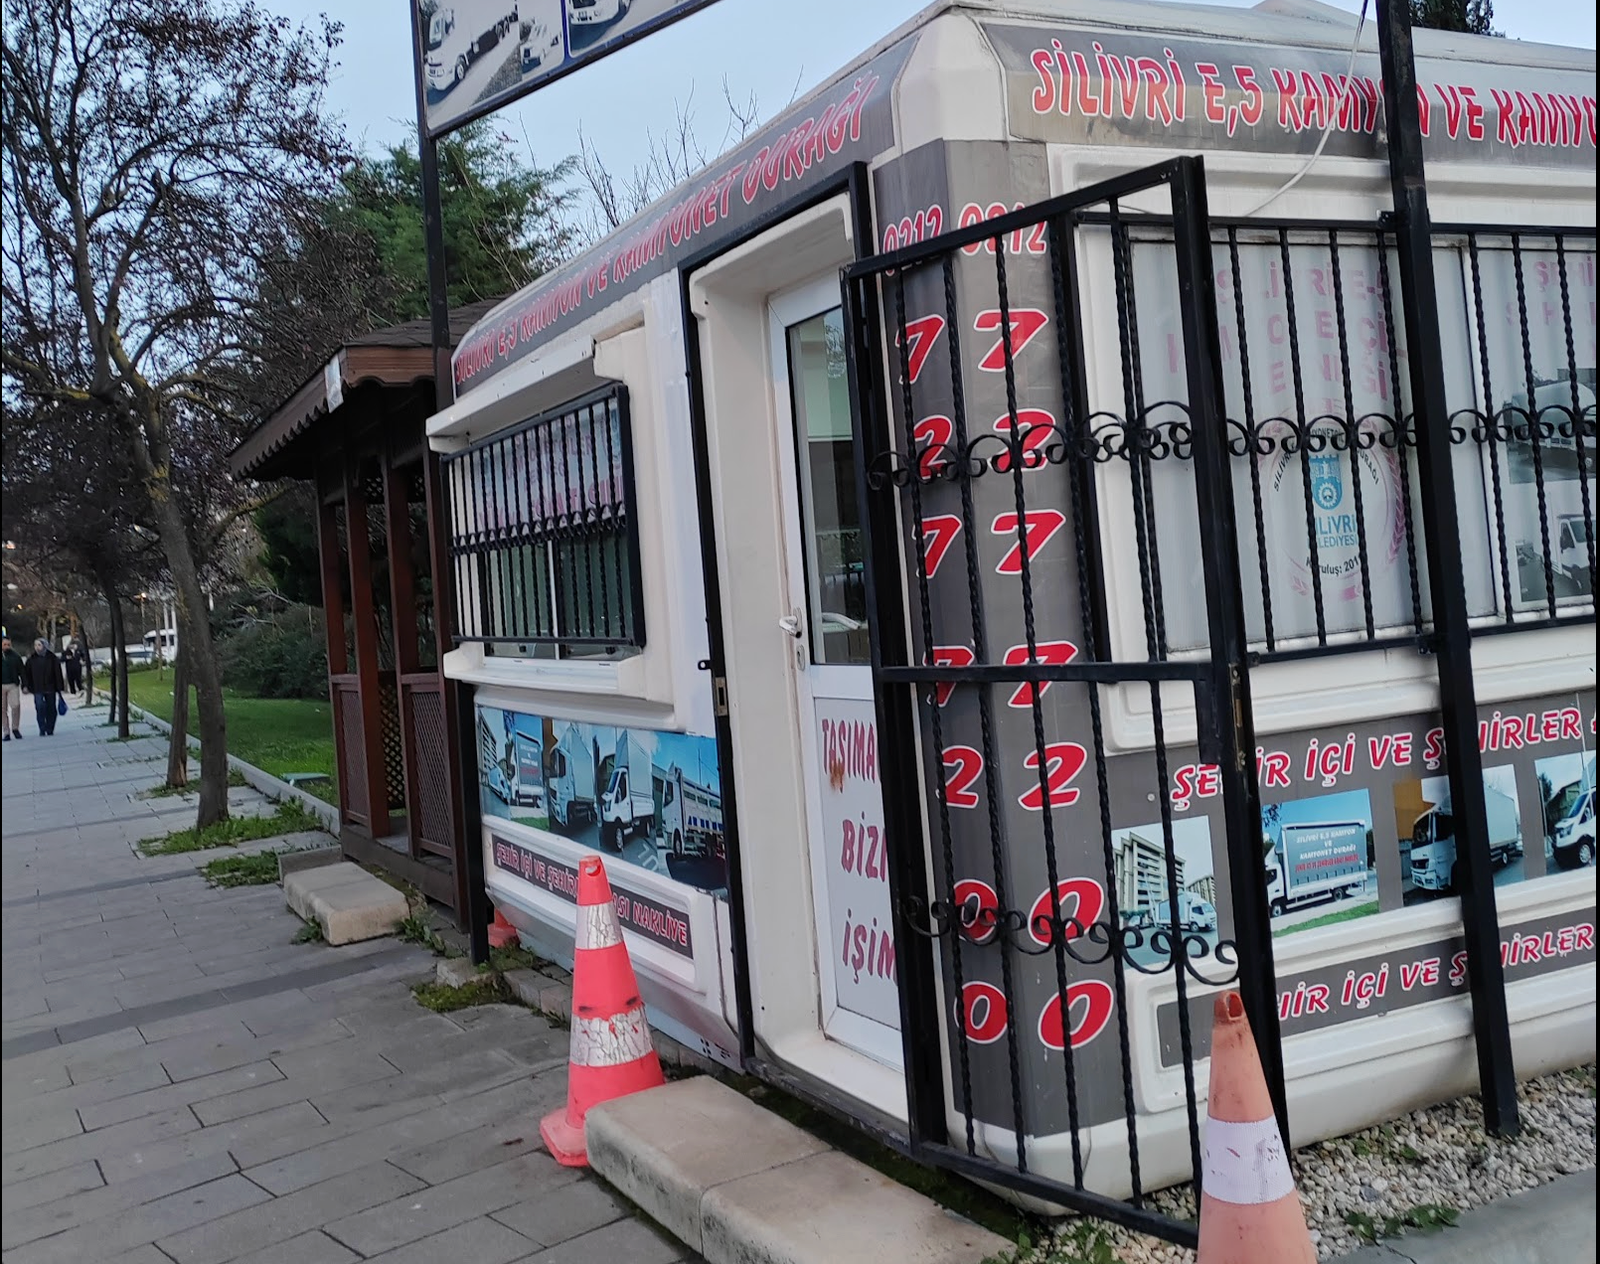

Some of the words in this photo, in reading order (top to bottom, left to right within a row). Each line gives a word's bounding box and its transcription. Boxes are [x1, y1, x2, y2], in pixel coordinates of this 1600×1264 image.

[1030, 37, 1187, 128] SİLİVRİ
[1270, 66, 1430, 138] KAMYN
[1434, 83, 1484, 142] VE
[1303, 733, 1357, 785] İÇİ
[1367, 732, 1413, 771] VE
[633, 900, 688, 947] NAKLİYE
[1341, 962, 1390, 1009] İÇİ
[1400, 957, 1442, 993] VE
